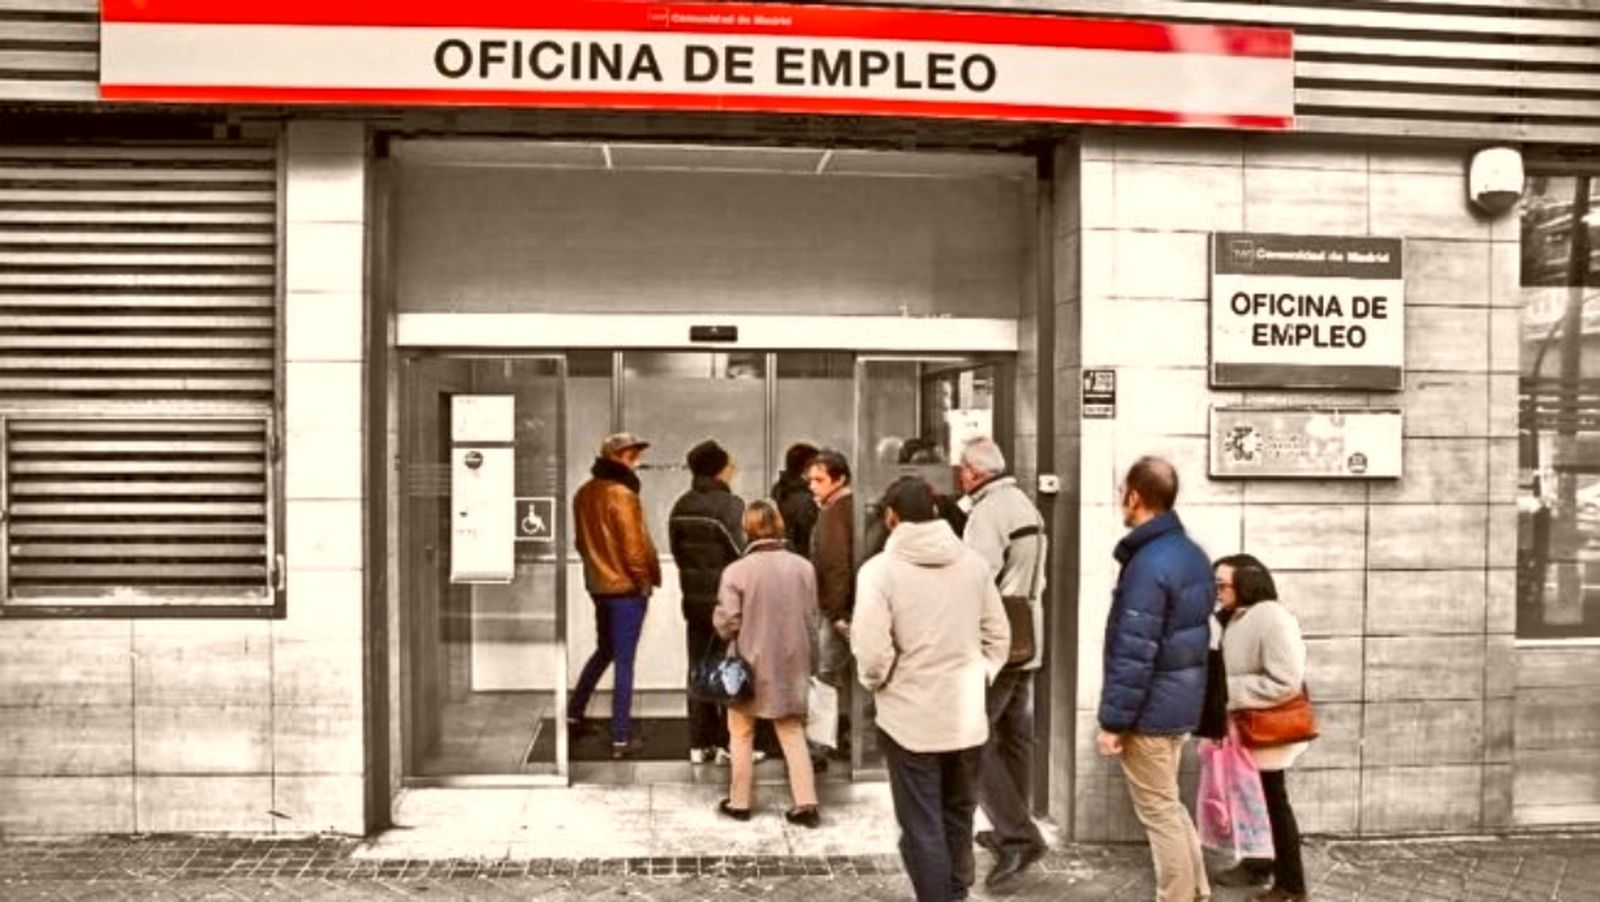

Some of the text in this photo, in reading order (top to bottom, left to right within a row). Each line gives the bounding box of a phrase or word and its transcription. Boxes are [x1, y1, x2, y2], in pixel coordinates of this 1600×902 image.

[433, 38, 997, 92] OFICINA DE EMPLEO
[1230, 291, 1388, 320] OFICINA DE
[1251, 322, 1367, 348] EMPLEO
